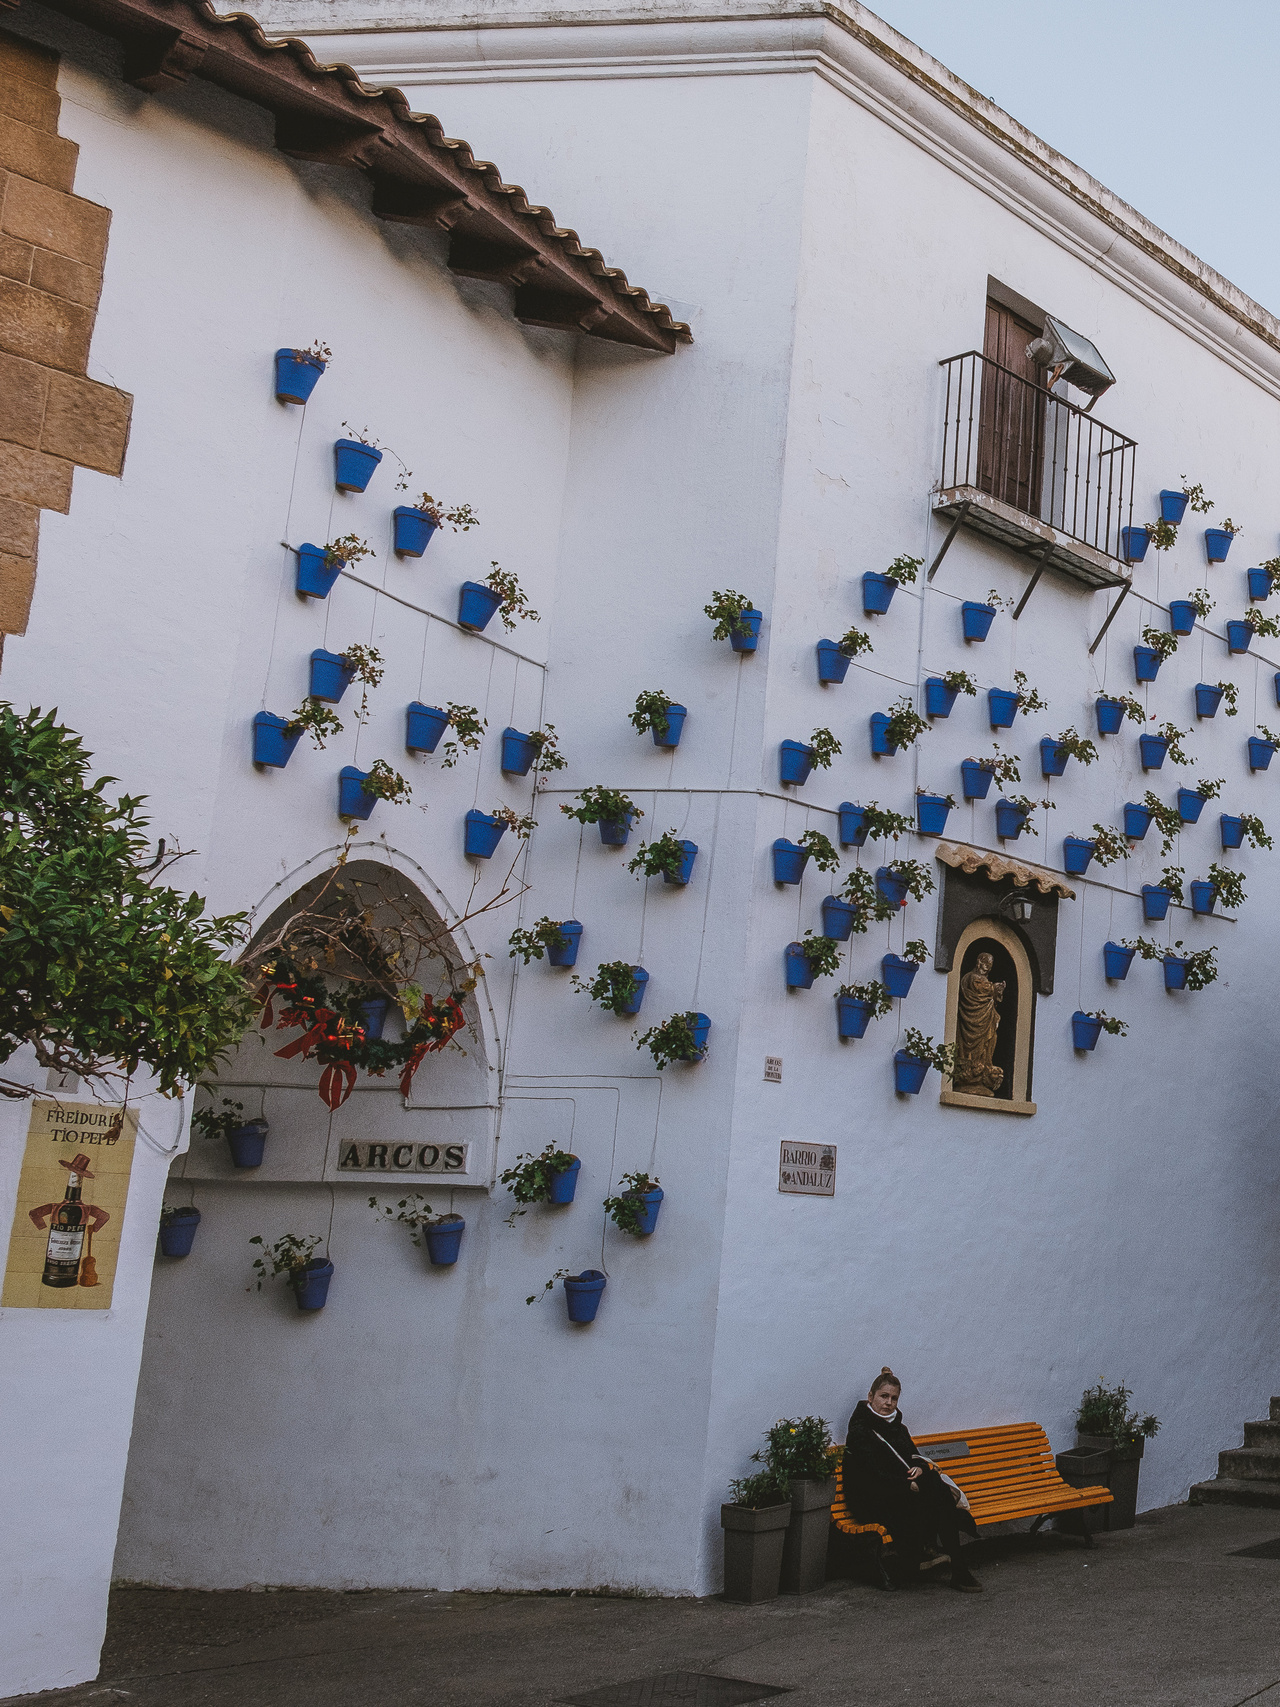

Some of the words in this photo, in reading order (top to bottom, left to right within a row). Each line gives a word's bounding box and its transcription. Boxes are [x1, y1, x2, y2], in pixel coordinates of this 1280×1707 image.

[340, 1144, 464, 1170] ARCOS
[782, 1148, 818, 1167] BARRIO
[790, 1172, 834, 1189] ANDALUZ
